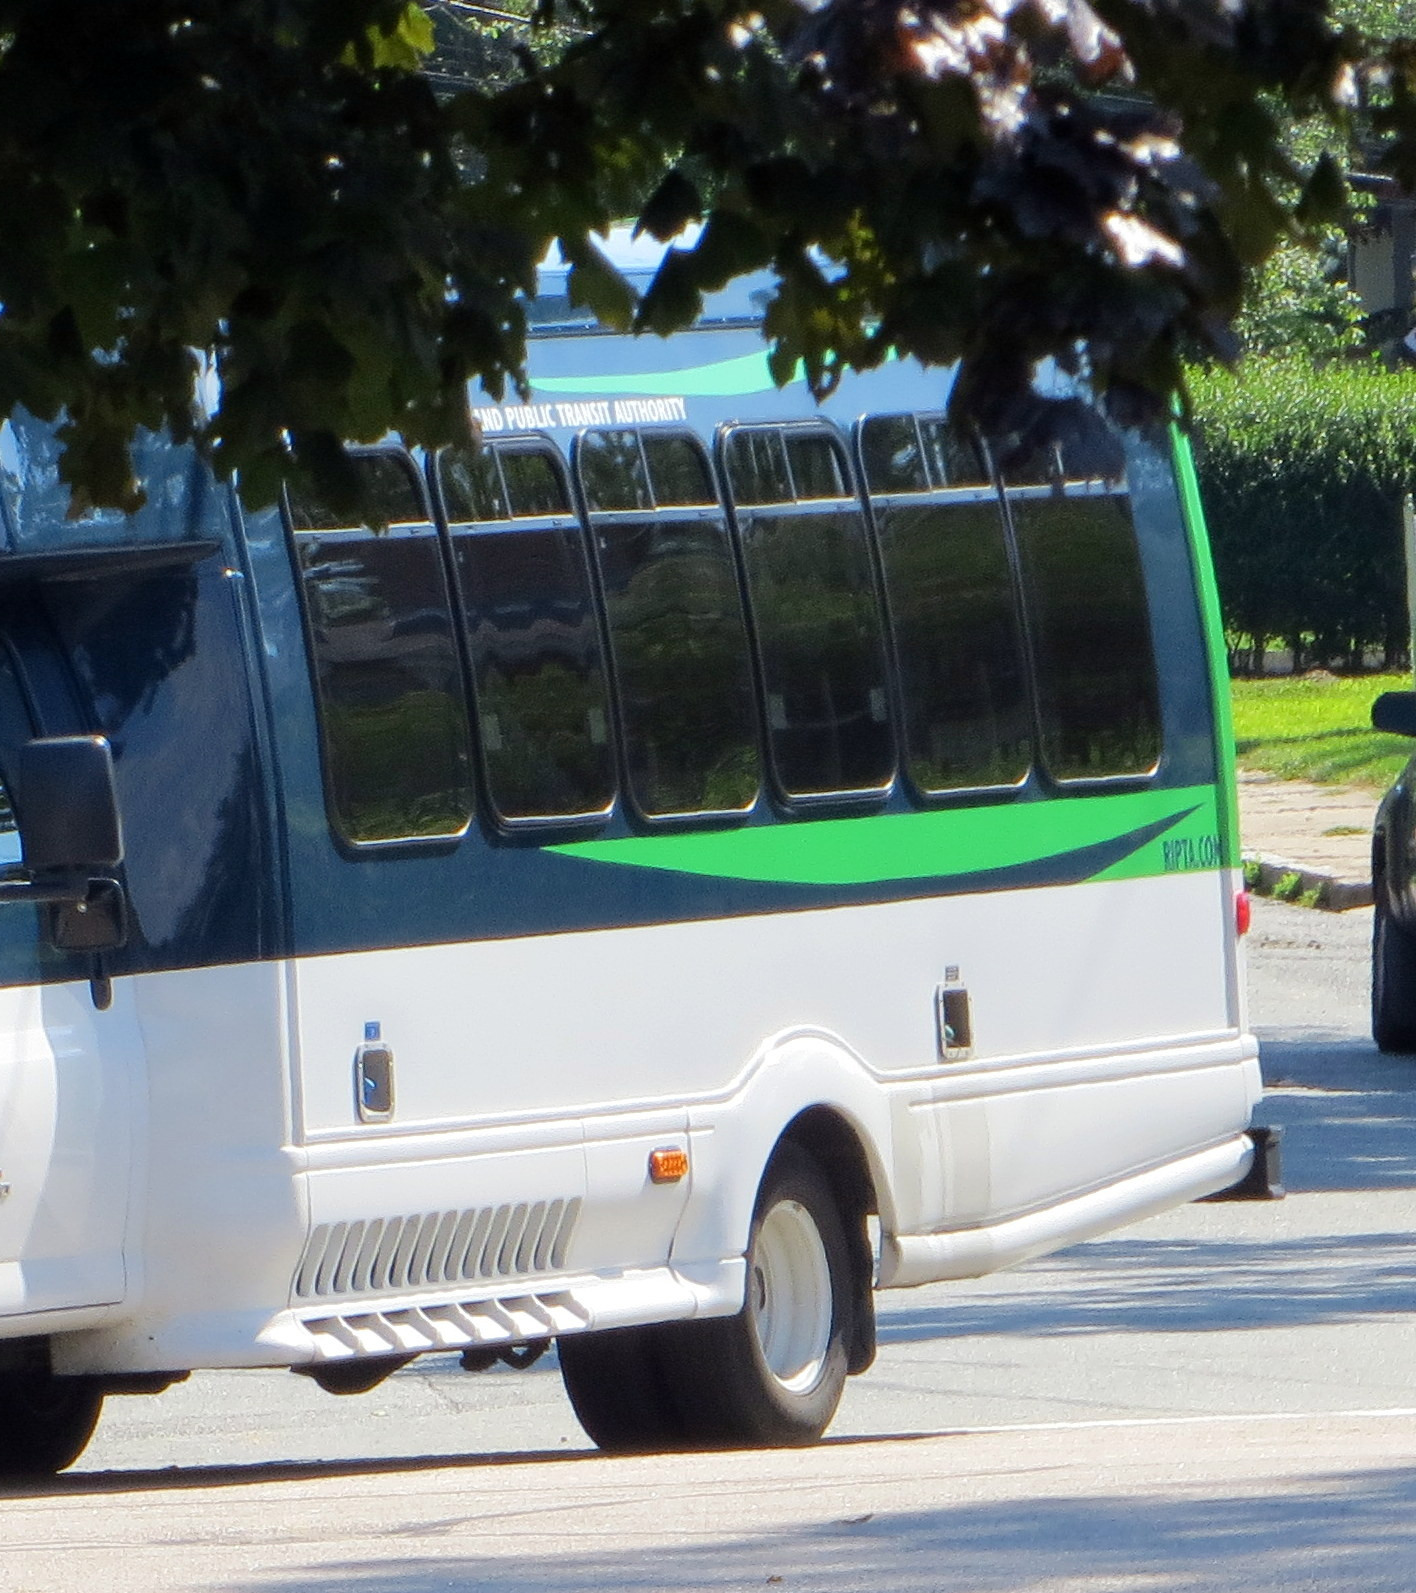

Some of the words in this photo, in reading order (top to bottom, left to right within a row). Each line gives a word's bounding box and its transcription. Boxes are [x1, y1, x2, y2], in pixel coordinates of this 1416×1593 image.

[505, 405, 556, 430] PUBLIC
[557, 402, 612, 428] TRANSIT
[614, 397, 687, 424] AUTHORITY
